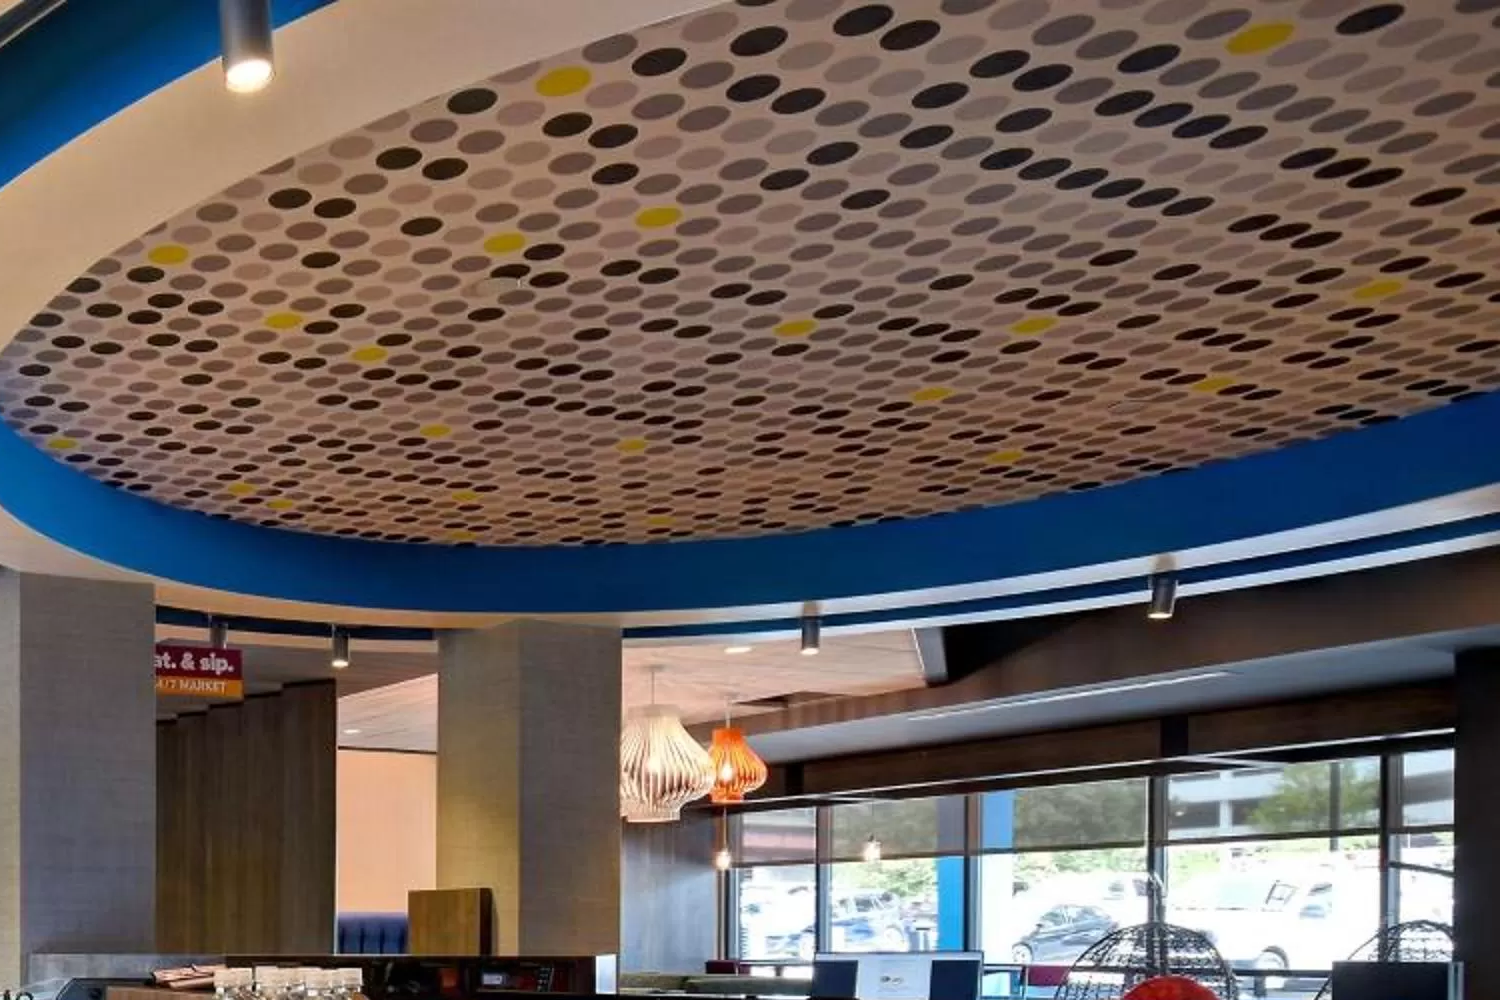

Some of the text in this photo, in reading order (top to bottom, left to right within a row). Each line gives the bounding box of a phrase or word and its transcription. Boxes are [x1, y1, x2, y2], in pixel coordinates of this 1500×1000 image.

[154, 652, 235, 675] at. & sip.
[180, 680, 225, 693] MARKET
